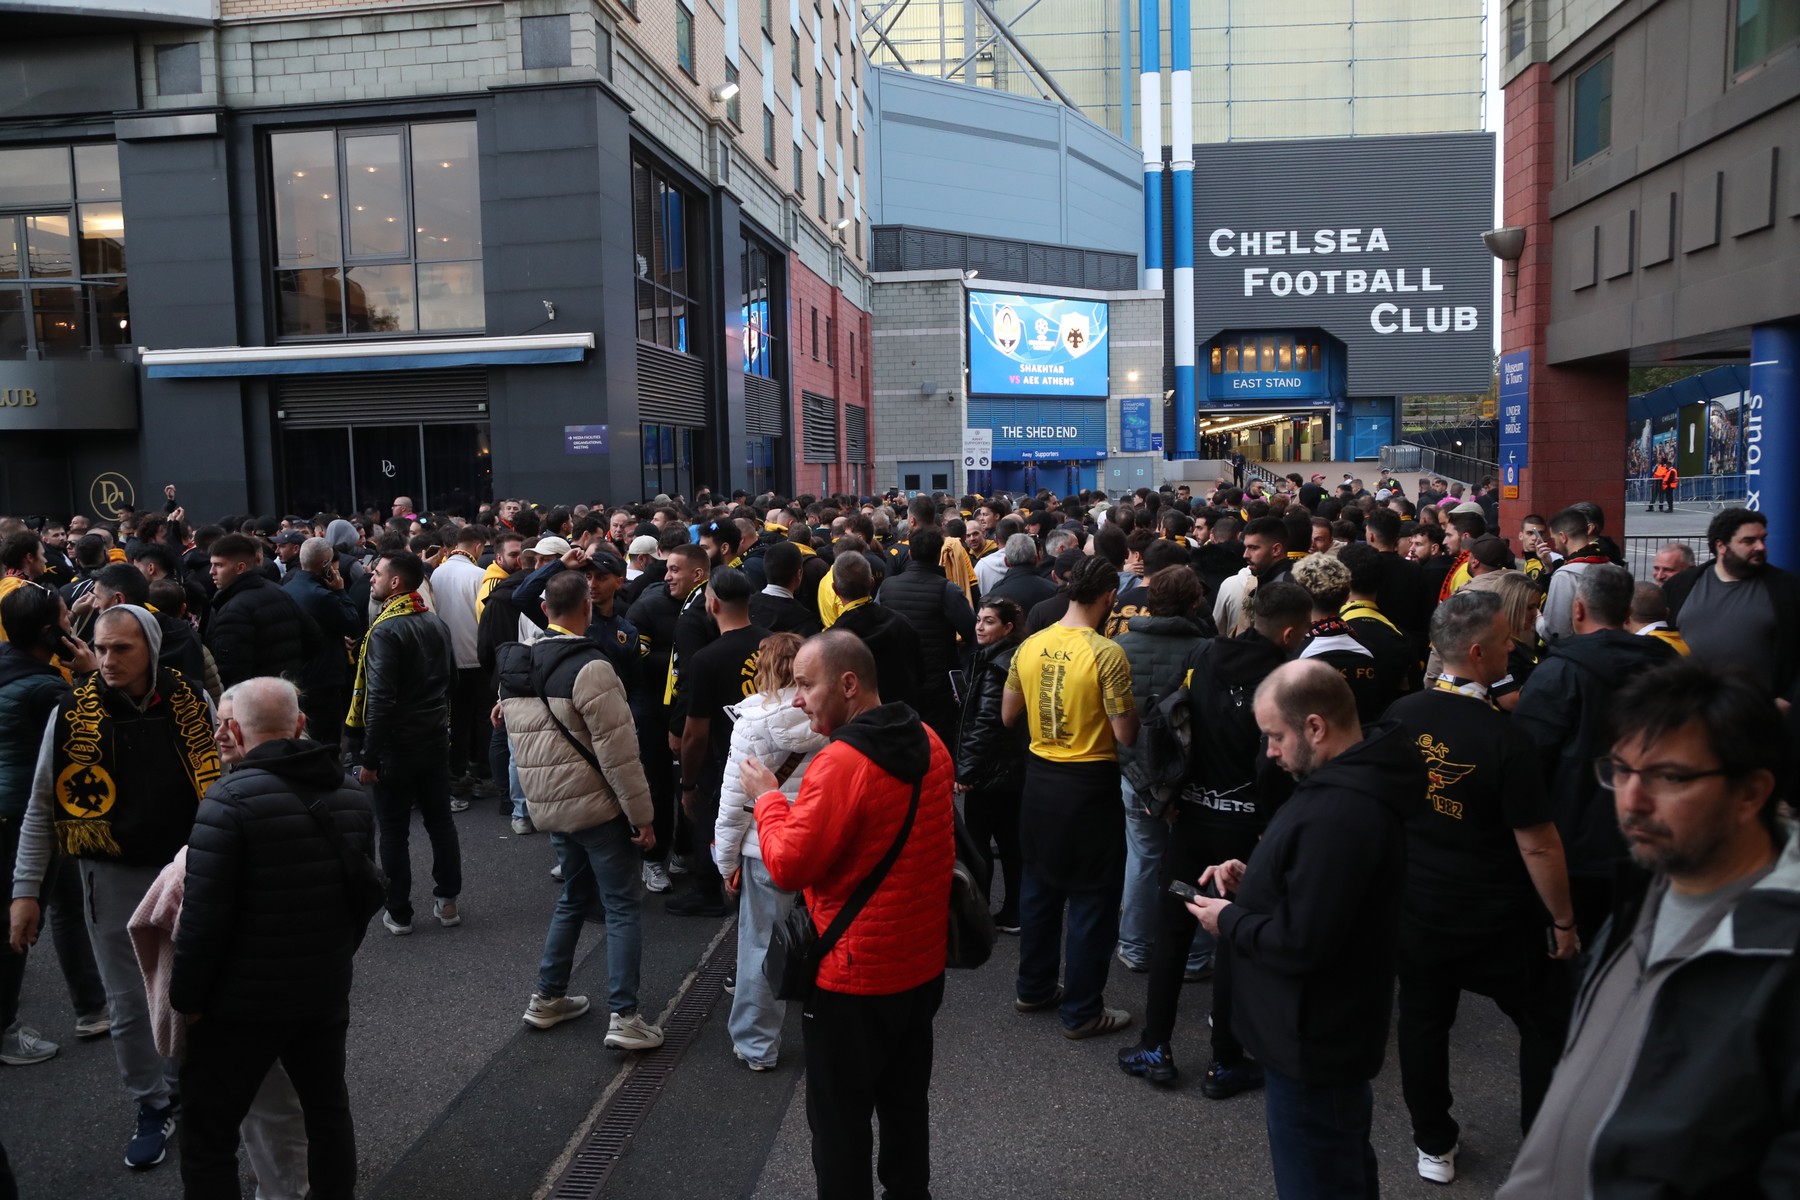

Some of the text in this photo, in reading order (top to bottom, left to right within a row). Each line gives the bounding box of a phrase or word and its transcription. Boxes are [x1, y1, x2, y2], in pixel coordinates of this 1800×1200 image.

[1208, 227, 1390, 257] CHELSEA
[1244, 267, 1444, 297] FOOTBALL
[1370, 302, 1479, 334] CLUB
[1019, 363, 1065, 374] SHAKHTAR
[1504, 362, 1524, 375] Museum
[1009, 375, 1075, 386] VS AEK ATHENS
[1232, 377, 1302, 389] EAST STAND
[1505, 373, 1523, 385] & Tours
[0, 388, 37, 407] UB
[1505, 405, 1521, 417] UNDER
[1001, 426, 1078, 438] THE SHED END
[1505, 423, 1521, 435] BRIDGE
[1034, 450, 1059, 458] Supporters
[382, 459, 396, 477] DC
[99, 480, 124, 515] DC
[1356, 667, 1375, 680] FC
[1181, 788, 1256, 813] SEAJETS
[1432, 794, 1463, 820] 1982
